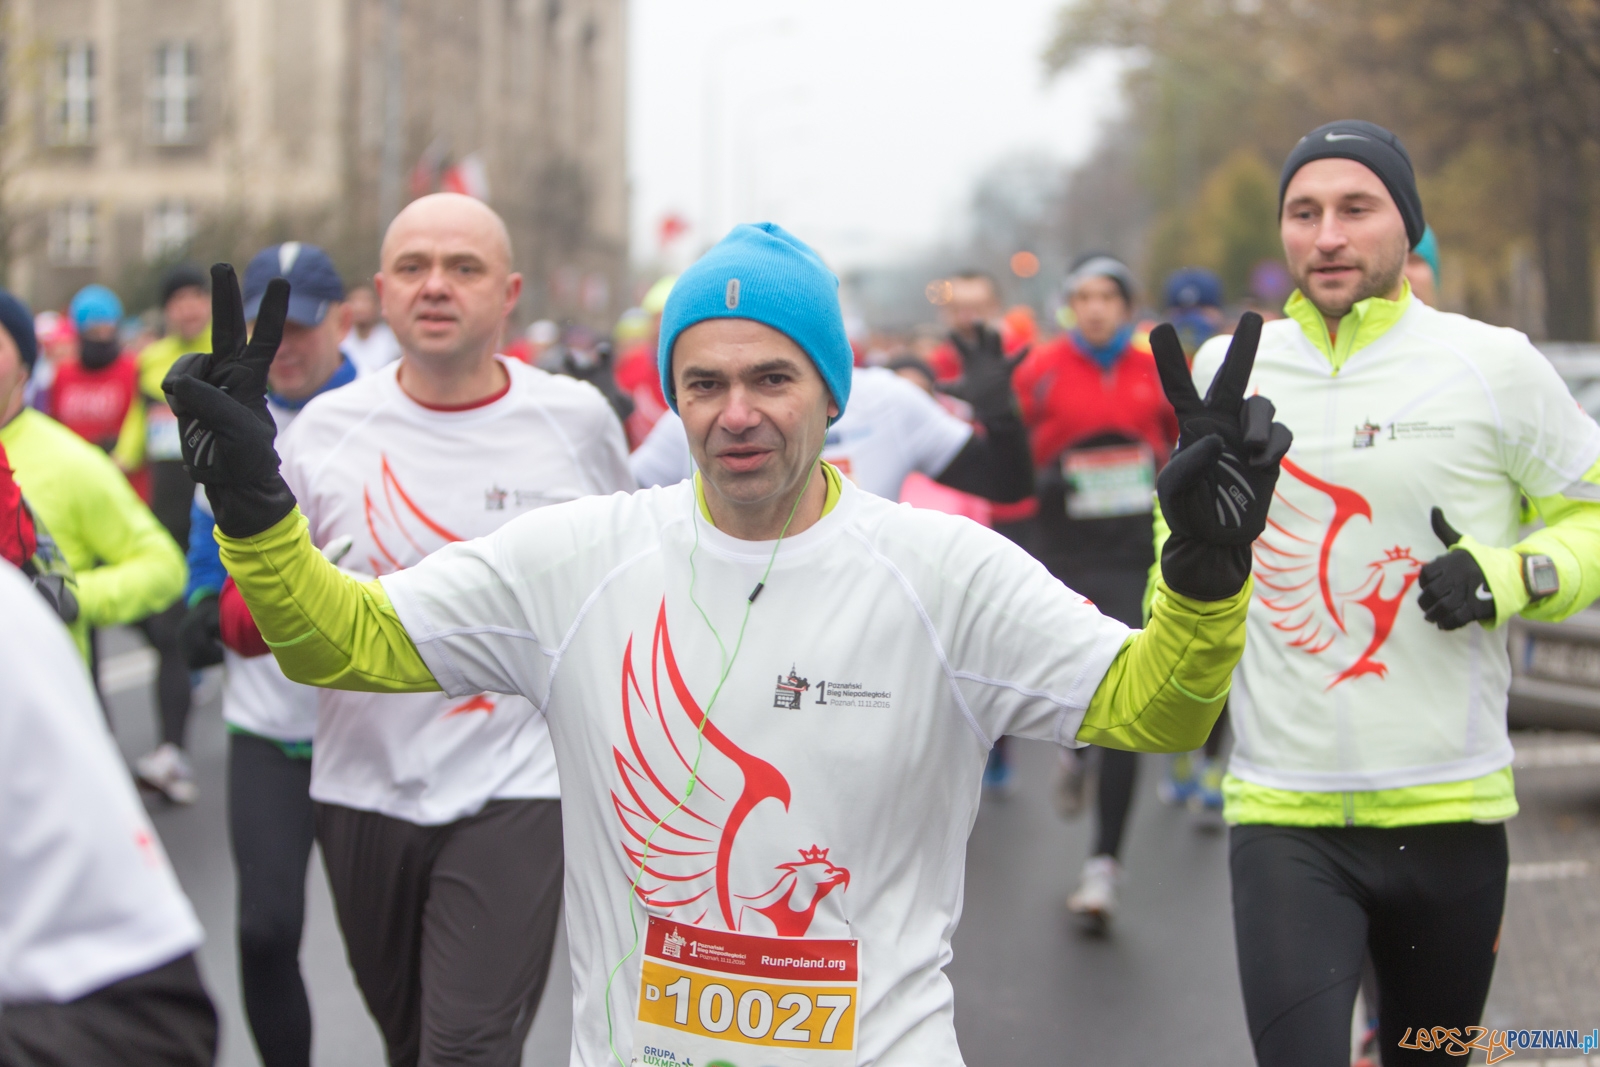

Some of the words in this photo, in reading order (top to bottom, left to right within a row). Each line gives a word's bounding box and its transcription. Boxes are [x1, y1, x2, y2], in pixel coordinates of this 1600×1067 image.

[187, 428, 206, 448] GEL
[1229, 484, 1248, 512] GEL
[815, 680, 827, 705] 1
[827, 682, 862, 690] Poznański
[843, 690, 892, 699] Niepodległości
[858, 700, 890, 708] 11.11.2016
[689, 940, 698, 958] 1
[761, 955, 846, 971] RunPoland.org
[645, 983, 660, 1002] D
[665, 976, 852, 1044] 10027
[644, 1045, 676, 1061] GRUPA
